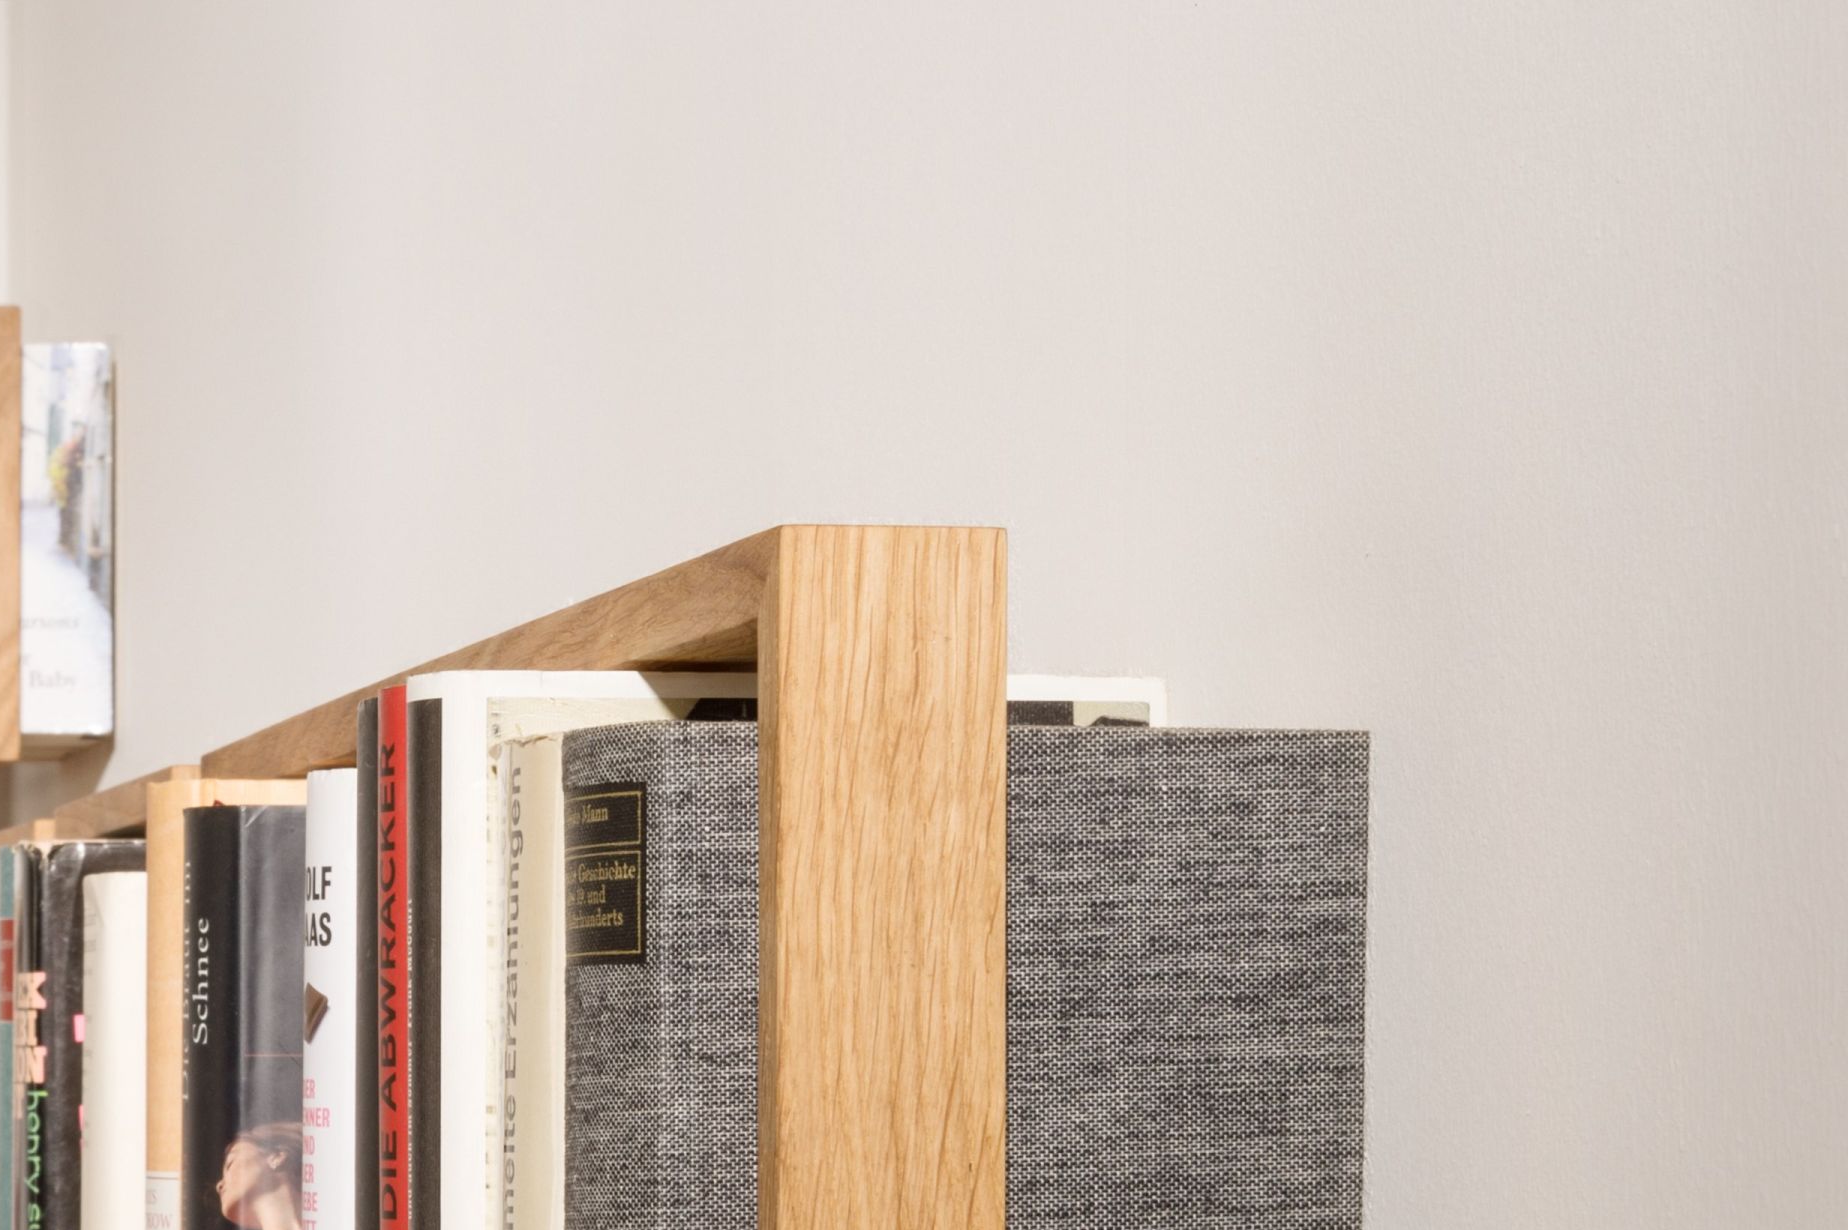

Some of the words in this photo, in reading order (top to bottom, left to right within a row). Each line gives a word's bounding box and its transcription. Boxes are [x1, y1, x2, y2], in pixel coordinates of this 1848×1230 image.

[577, 858, 637, 884] Geschichte
[380, 741, 398, 1112] ABWRACKER
[192, 917, 209, 1045] Schnee
[25, 1090, 49, 1194] henry
[380, 1131, 397, 1221] DIE
